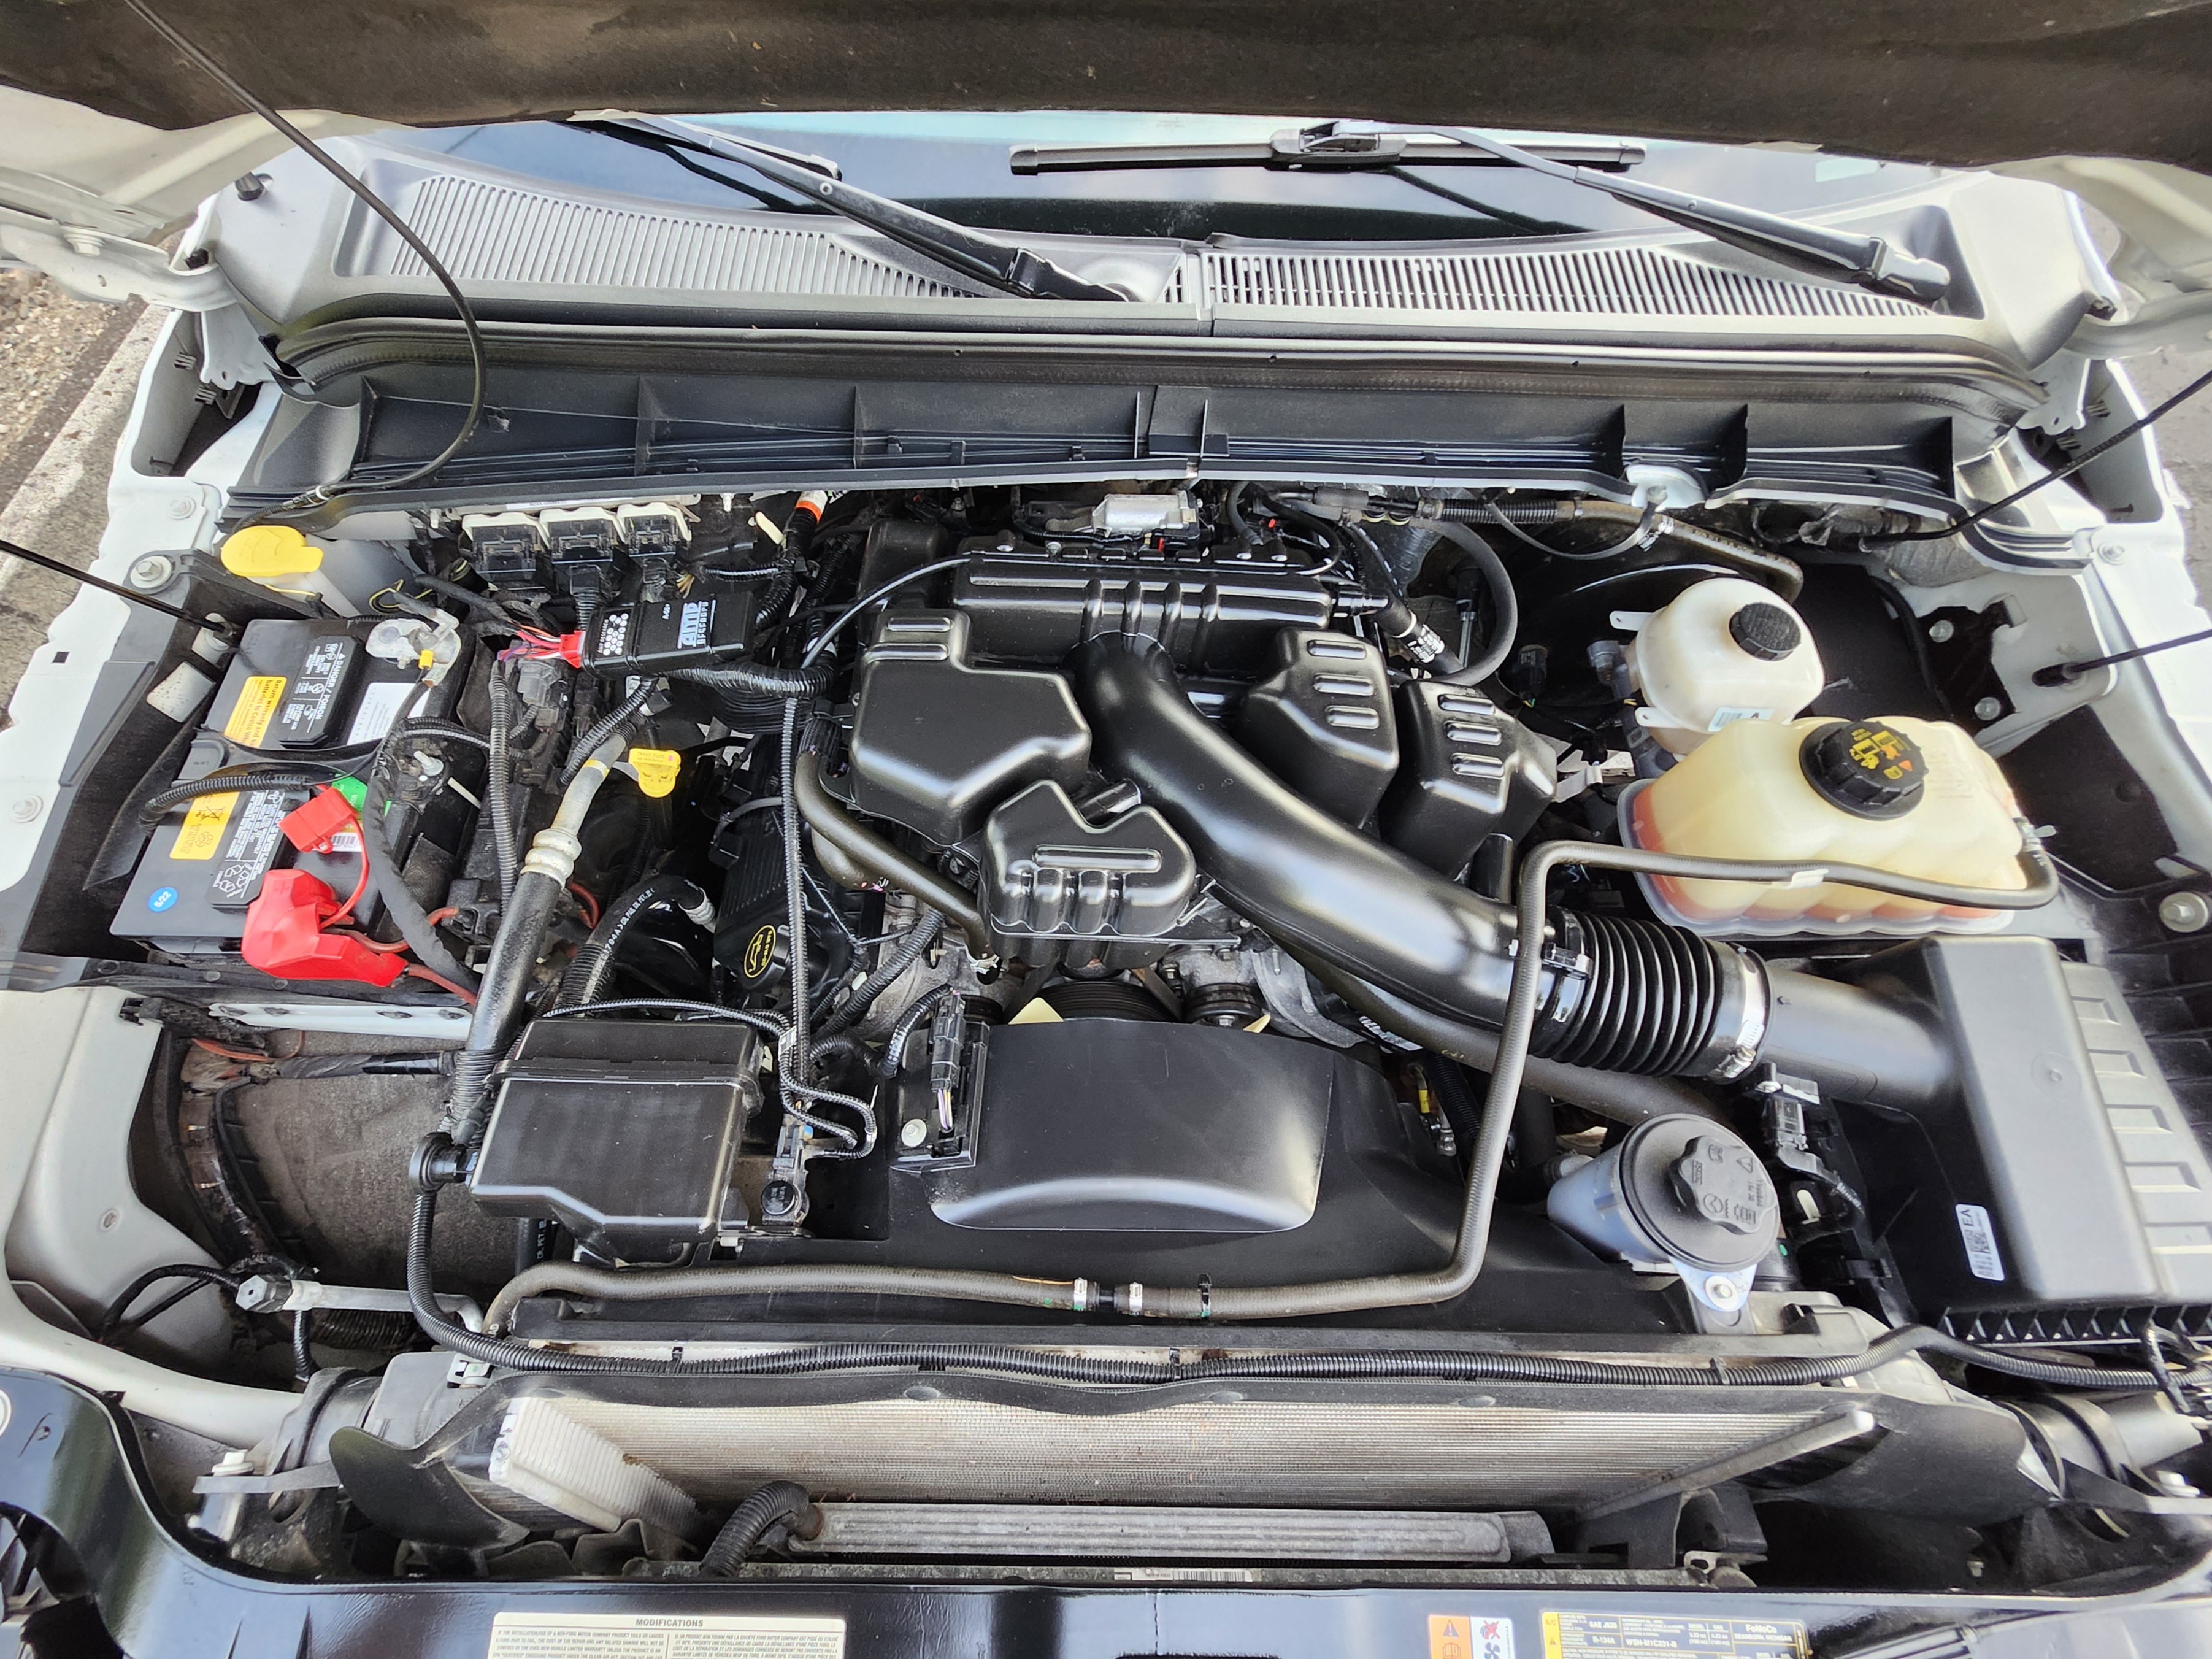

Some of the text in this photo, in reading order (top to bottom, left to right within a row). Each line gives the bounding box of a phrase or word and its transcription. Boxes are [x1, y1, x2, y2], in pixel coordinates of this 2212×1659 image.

[682, 602, 699, 645] AMP
[696, 601, 709, 644] RESEARCH
[327, 660, 344, 688] DANGER
[258, 680, 273, 704] batteries
[269, 680, 282, 699] Return
[256, 700, 272, 725] warranty
[315, 694, 331, 720] POISON
[246, 712, 259, 731] Costco
[253, 727, 261, 738] and
[1960, 1209, 1974, 1226] EA
[636, 1619, 704, 1627] MODIFICATIONS
[1745, 1624, 1777, 1633] FoMoCo
